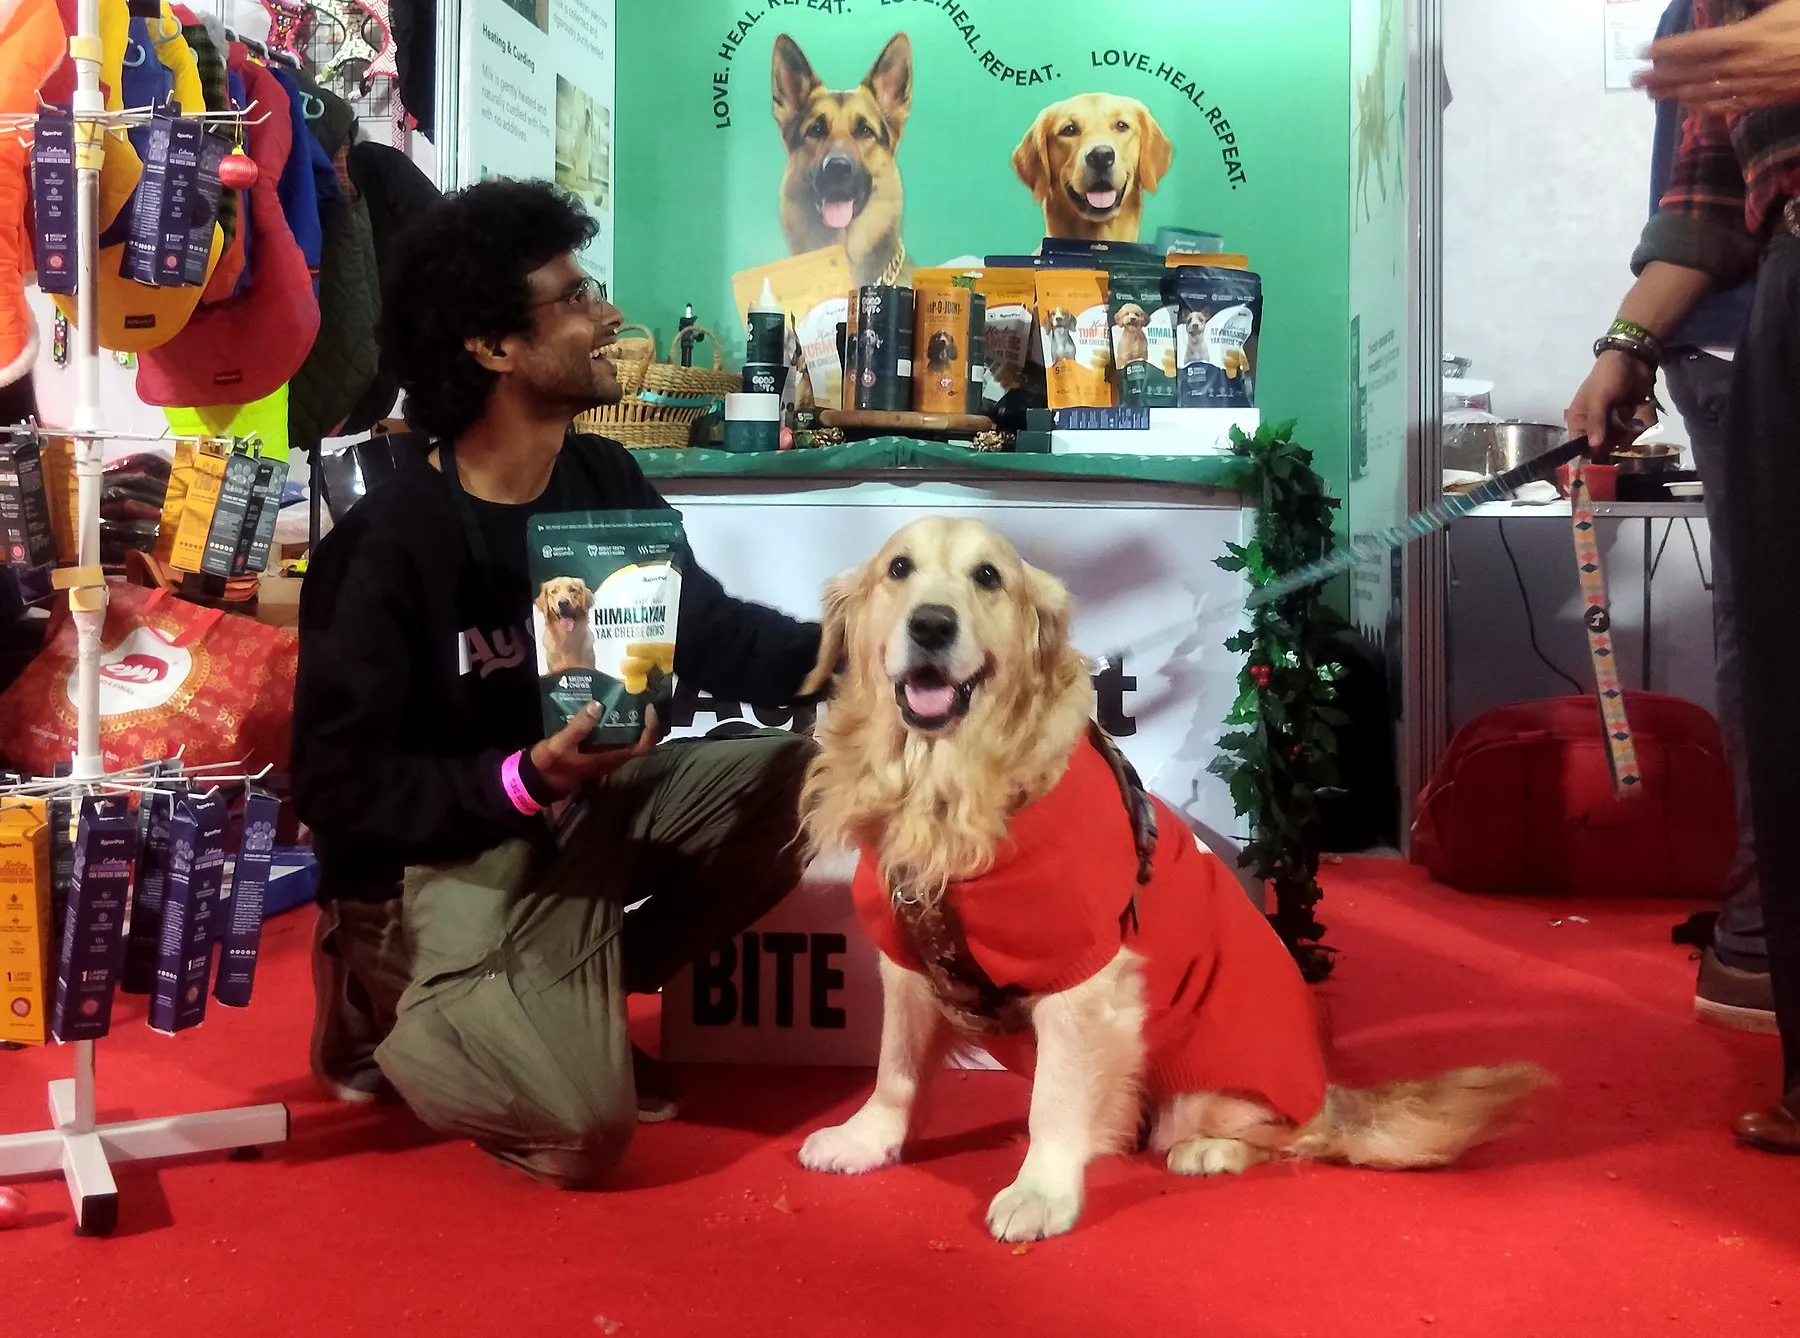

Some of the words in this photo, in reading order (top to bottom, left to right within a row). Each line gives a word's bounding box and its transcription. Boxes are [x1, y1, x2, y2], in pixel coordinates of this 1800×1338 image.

[482, 23, 506, 54] Heating
[507, 41, 512, 55] &
[512, 46, 535, 74] Curding
[718, 10, 765, 61] HEAL.
[941, 0, 981, 54] HEAL.
[978, 50, 1061, 86] REPEAT.
[481, 87, 505, 112] naturally
[506, 102, 527, 122] curdled
[500, 79, 517, 100] gently
[518, 87, 537, 110] heated
[538, 103, 547, 117] and
[713, 67, 731, 129] LOVE.
[481, 106, 493, 123] with
[1091, 50, 1153, 74] LOVE.
[1155, 62, 1206, 112] HEAL.
[1204, 106, 1247, 191] REPEAT.
[752, 375, 775, 385] GOOD
[1187, 367, 1194, 376] 5
[594, 605, 666, 626] HIMALAYAN
[595, 628, 614, 640] YAK
[614, 626, 646, 639] CHEESE
[646, 624, 665, 637] CHEWS
[559, 675, 568, 689] 4
[103, 857, 127, 866] Calming
[6, 972, 12, 982] 1
[691, 931, 847, 1030] BITE
